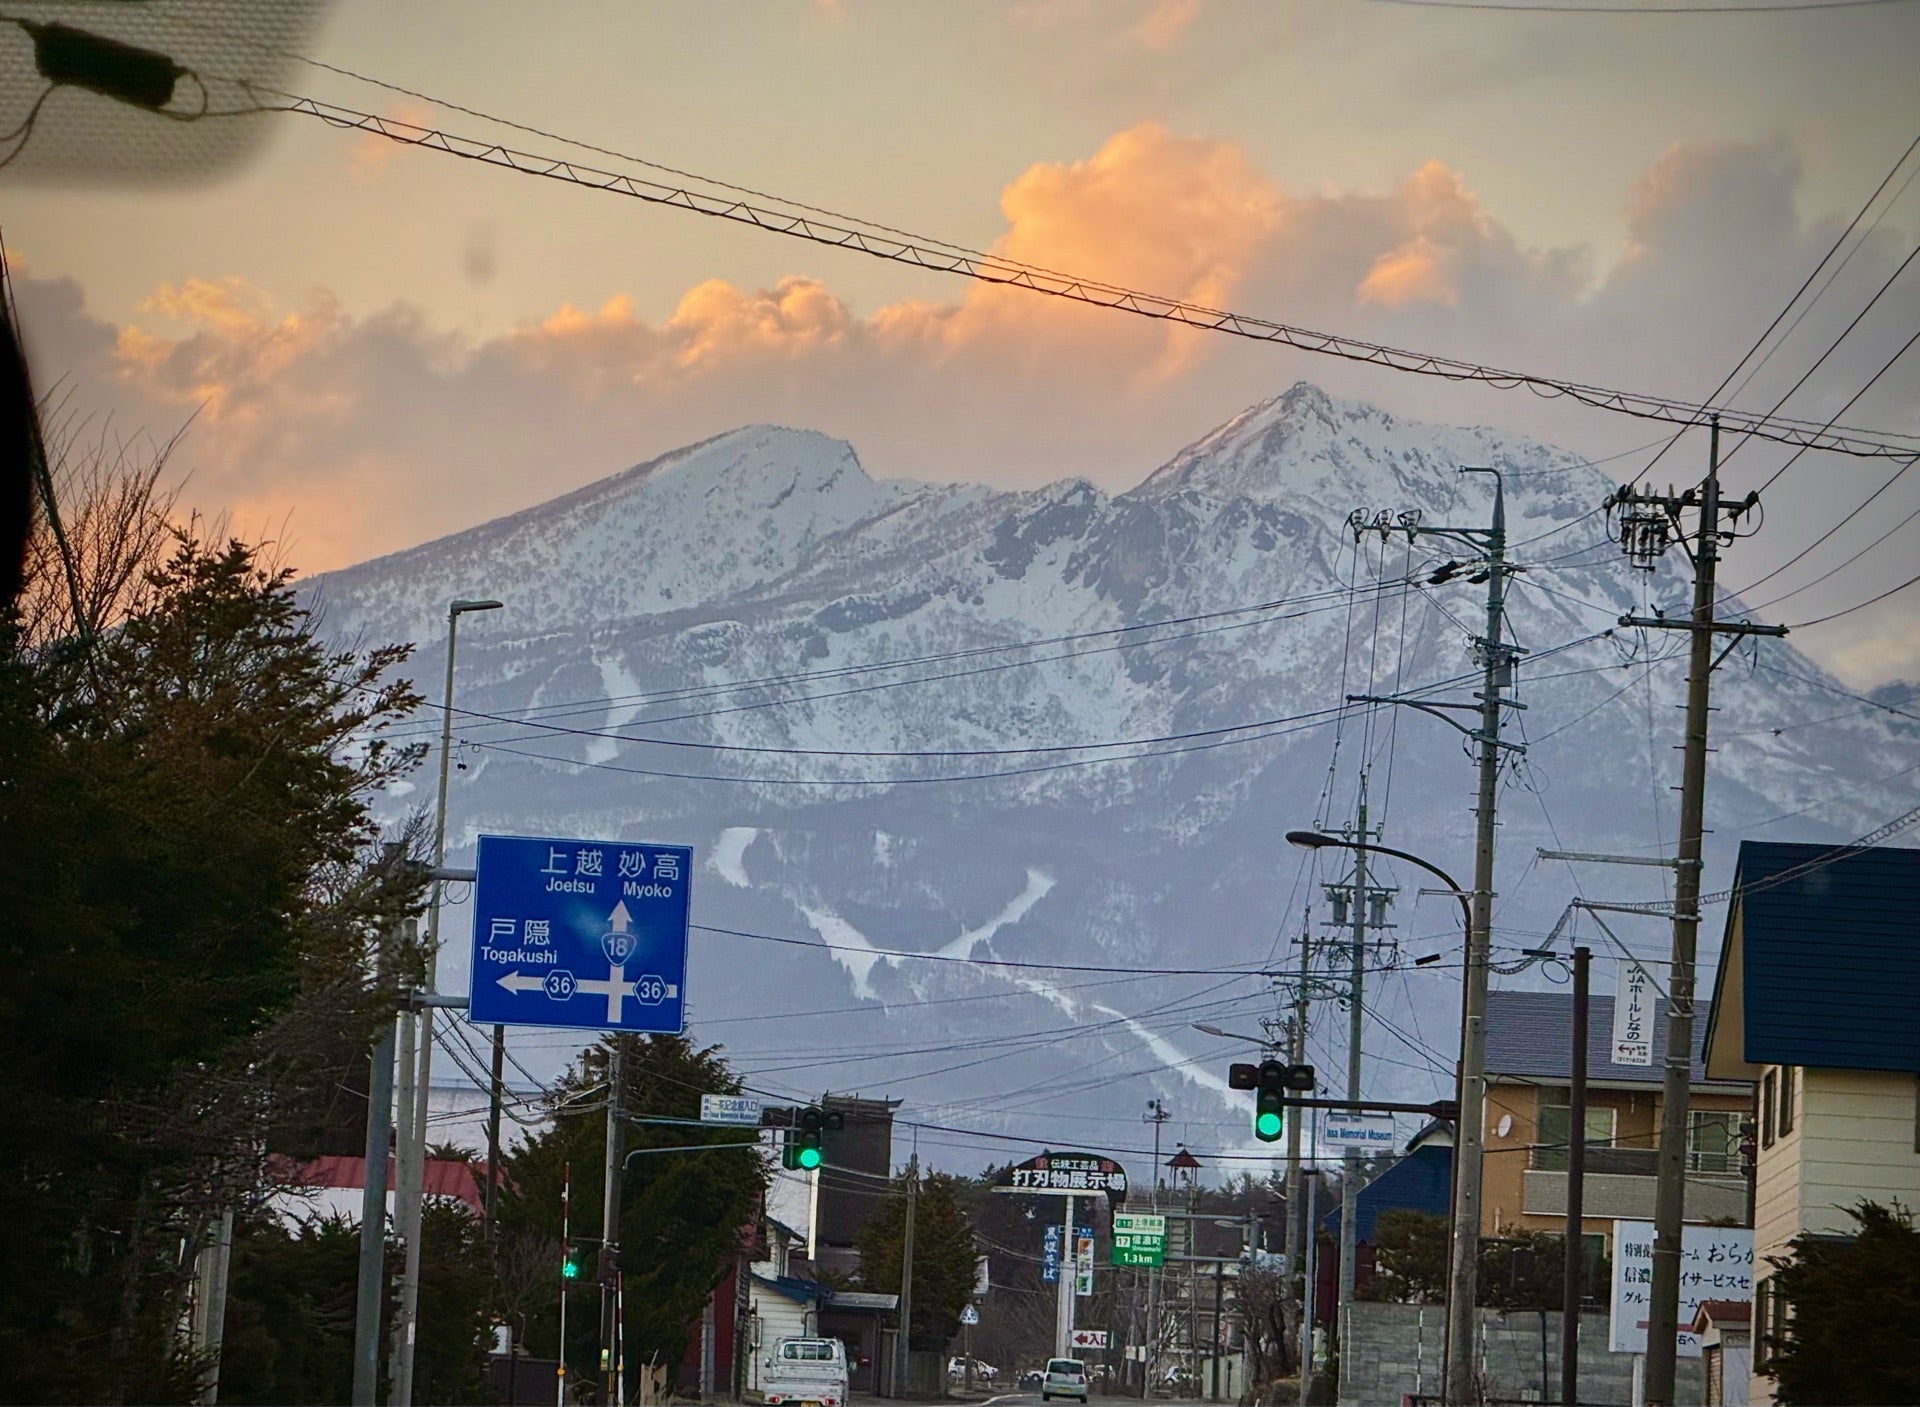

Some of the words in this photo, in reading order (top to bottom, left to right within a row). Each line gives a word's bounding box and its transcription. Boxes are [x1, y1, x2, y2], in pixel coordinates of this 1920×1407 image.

[540, 846, 602, 876] 上越
[618, 851, 680, 881] 妙高
[545, 877, 595, 894] Joetsu
[623, 881, 672, 899] Myoko
[488, 918, 550, 945] 戸隠
[481, 946, 557, 964] Togakushi
[608, 938, 628, 957] 18
[550, 976, 570, 994] 36
[640, 982, 661, 999] 36
[1626, 975, 1645, 1040] JAホールしなの
[1326, 1128, 1338, 1138] Issa
[1340, 1128, 1366, 1139] Memorial
[1368, 1129, 1392, 1140] Museum
[1050, 1159, 1099, 1171] 伝統工芸品
[1012, 1168, 1125, 1191] 打刃物展示場
[1117, 1237, 1129, 1246] 17
[1043, 1227, 1058, 1280] 黒姫そば
[1678, 1335, 1697, 1345] 右へ
